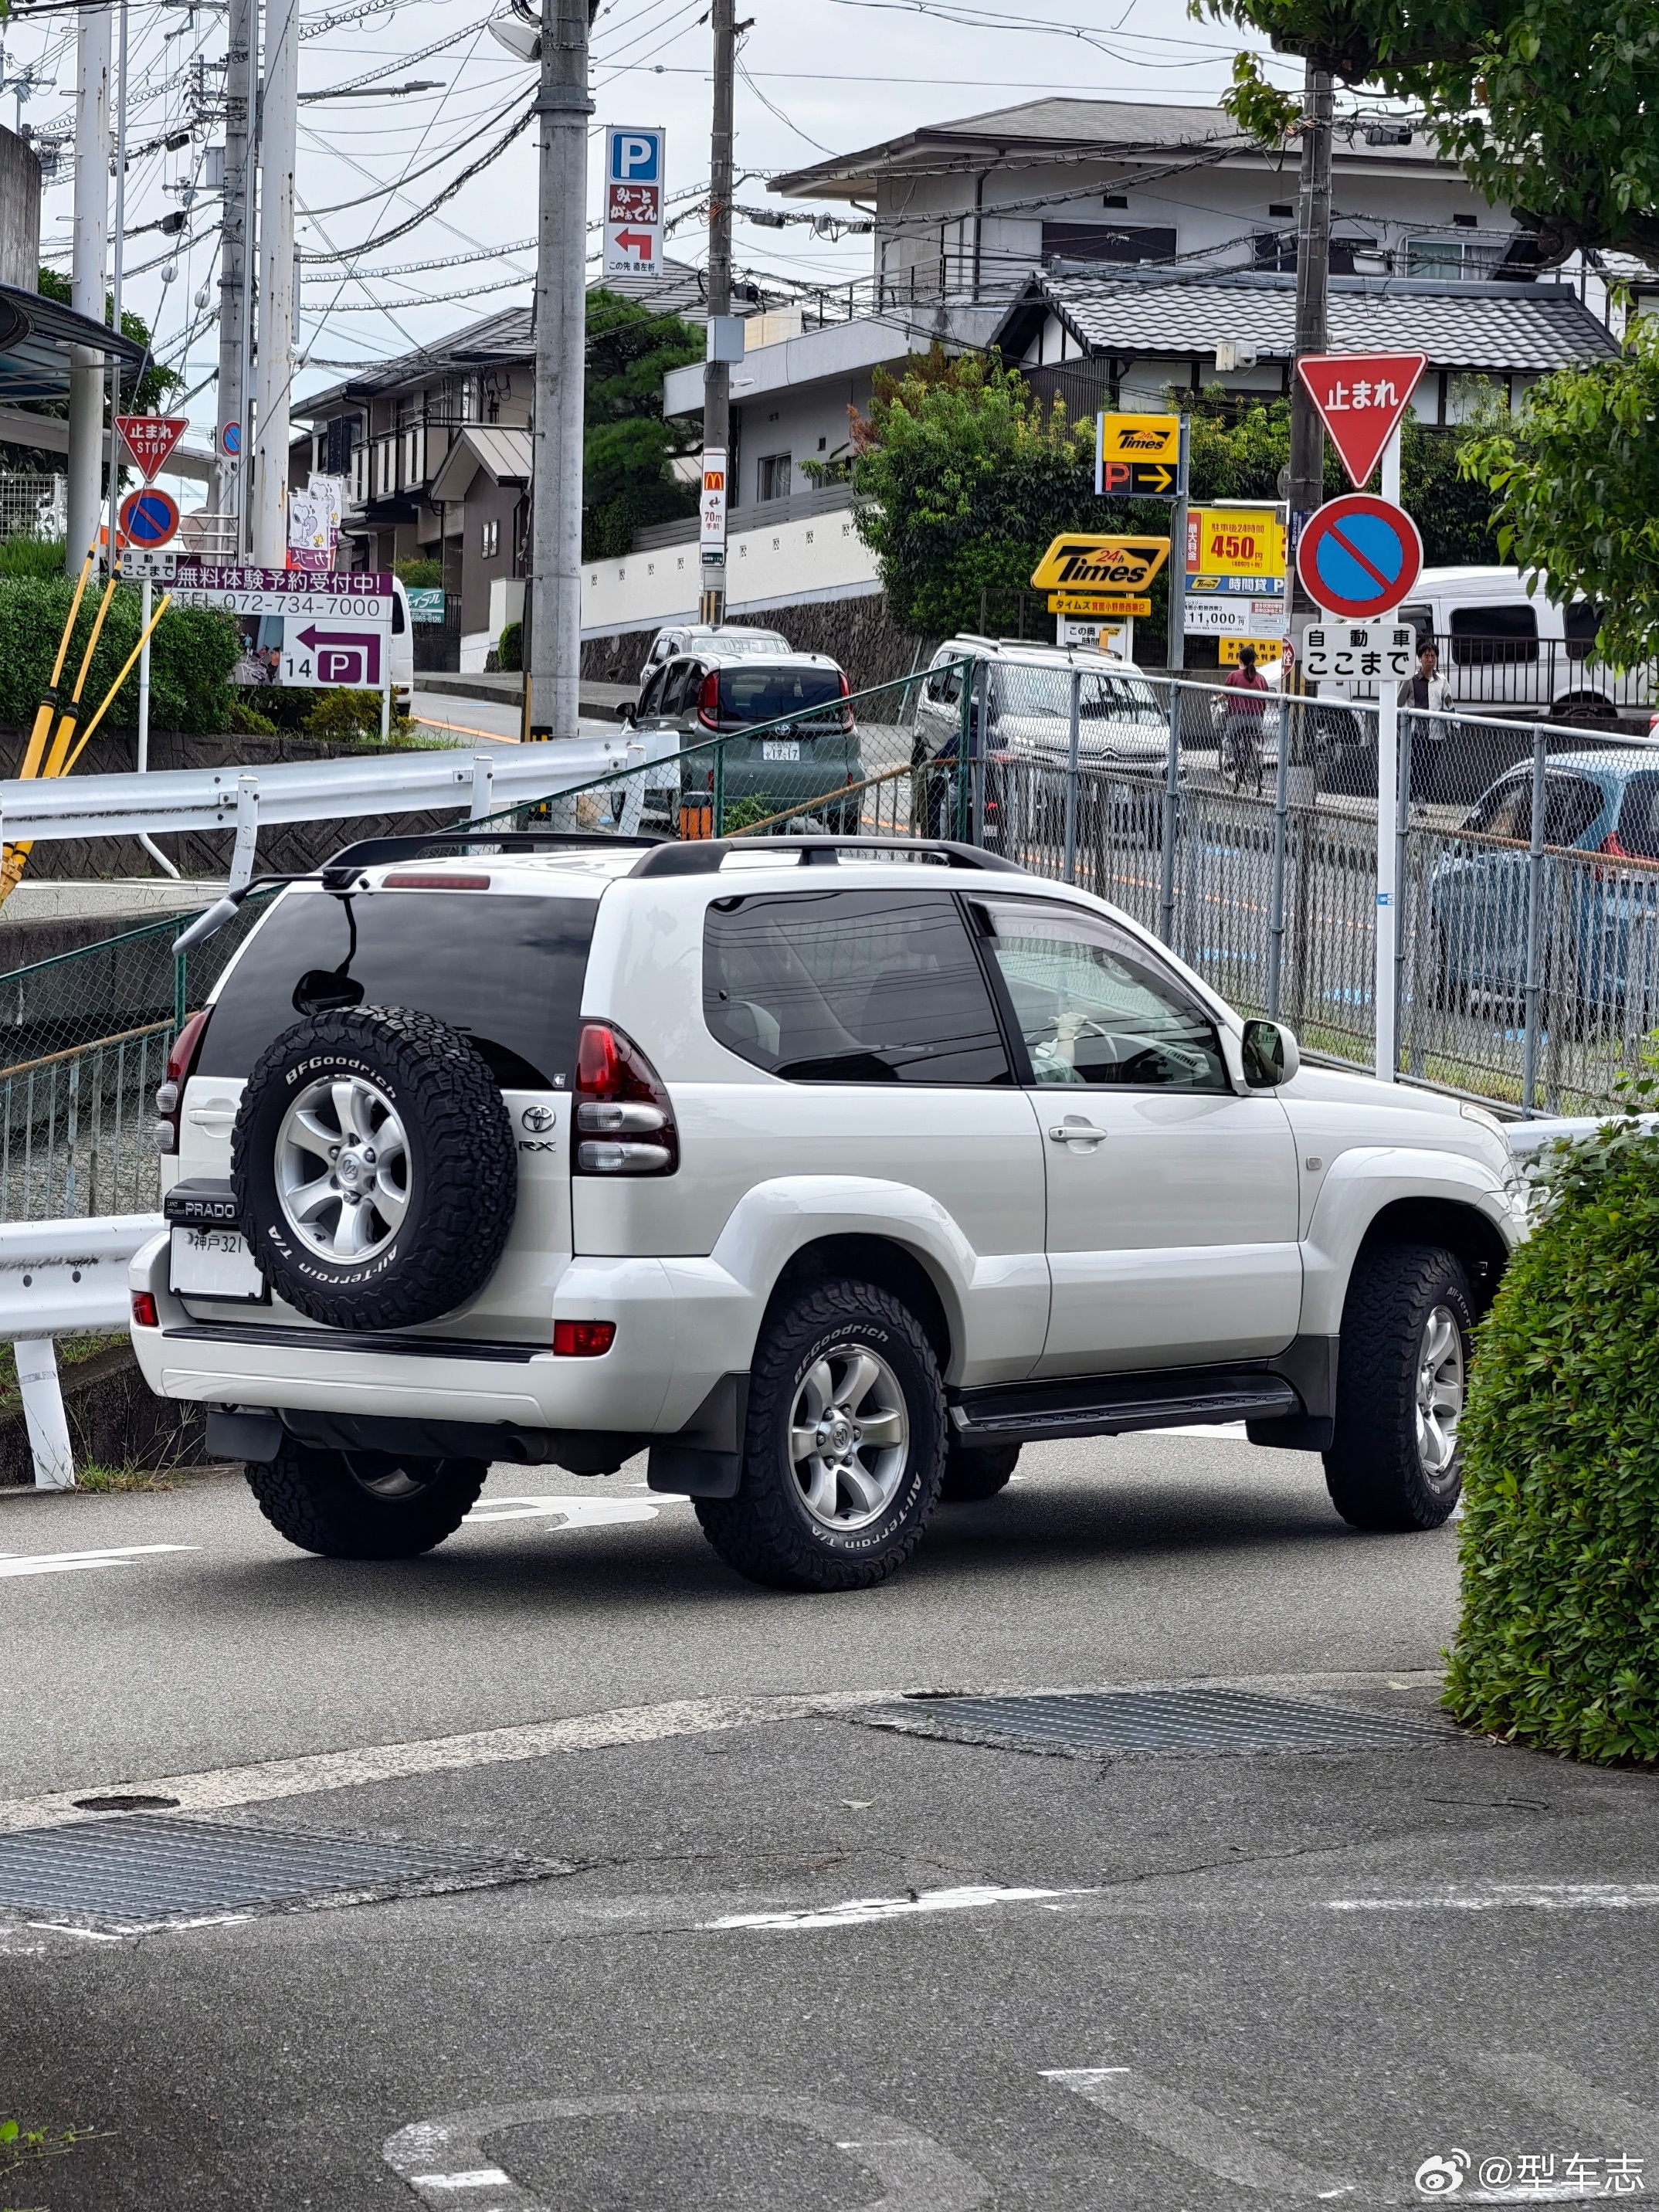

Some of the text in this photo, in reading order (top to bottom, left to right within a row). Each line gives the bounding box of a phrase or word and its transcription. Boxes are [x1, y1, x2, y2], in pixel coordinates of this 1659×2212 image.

[620, 137, 653, 178] P
[616, 187, 652, 205] みーと
[609, 204, 657, 222] がぁでん
[609, 262, 631, 271] この先
[1324, 378, 1399, 412] 止まれ
[129, 423, 174, 439] 止まれ
[137, 441, 167, 455] STOP
[1118, 435, 1165, 450] Times
[1104, 462, 1130, 492] P
[704, 511, 723, 523] 70m
[706, 522, 720, 531] 手前
[123, 553, 174, 564] 自動車
[122, 565, 175, 577] ここまで
[1057, 556, 1148, 583] Times
[177, 565, 381, 595] 無料体験予約受付中!
[1228, 577, 1267, 592] 時間貸
[222, 593, 381, 617] 072-734-7000
[1056, 599, 1091, 611] タイムズ
[1069, 626, 1096, 637] この奥
[1308, 629, 1411, 648] 自動車
[285, 658, 312, 678] 14
[329, 653, 350, 680] P
[1307, 650, 1410, 677] ここまで
[284, 1056, 398, 1100] BFGoodrich
[518, 1139, 557, 1152] RX
[185, 1203, 236, 1219] PRADO
[267, 1224, 399, 1284] All-Terrain T/A
[794, 1322, 890, 1385] BFGoodrich
[811, 1471, 922, 1551] All-Terrain T/A
